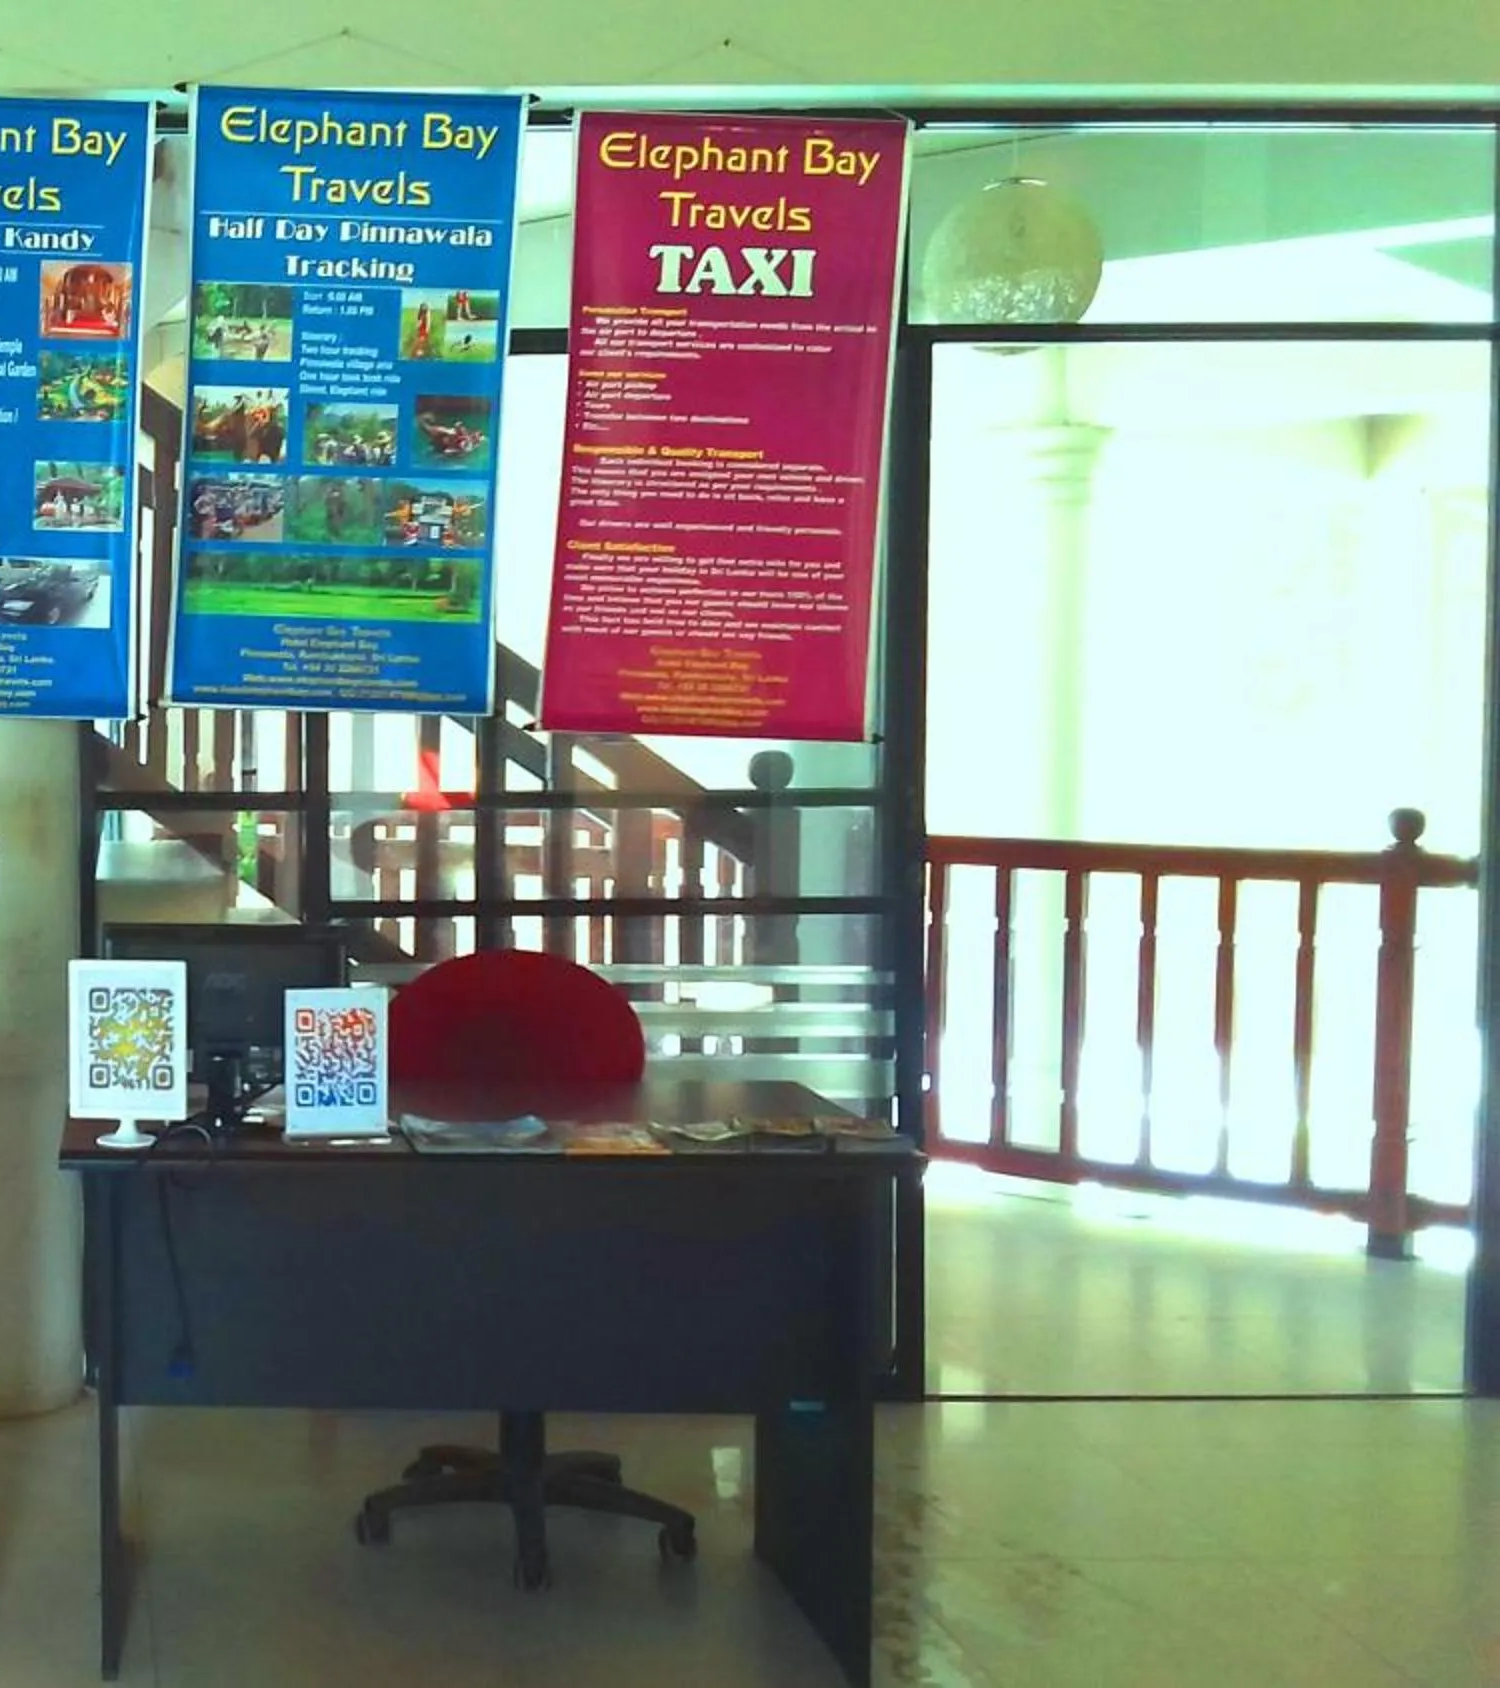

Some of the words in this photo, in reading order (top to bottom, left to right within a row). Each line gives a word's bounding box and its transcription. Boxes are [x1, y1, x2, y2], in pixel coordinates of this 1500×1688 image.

[51, 118, 127, 166] Bay
[220, 105, 407, 154] Elephant
[422, 112, 498, 160] Bay
[599, 132, 789, 180] Elephant
[803, 138, 880, 187] Bay
[279, 165, 432, 205] Travels
[209, 216, 265, 239] Half
[275, 218, 329, 242] Day
[339, 220, 493, 247] Pinnawala
[659, 191, 812, 232] Travels
[4, 227, 96, 251] Kandy
[285, 255, 415, 283] Tracking
[649, 244, 817, 298] TAXI
